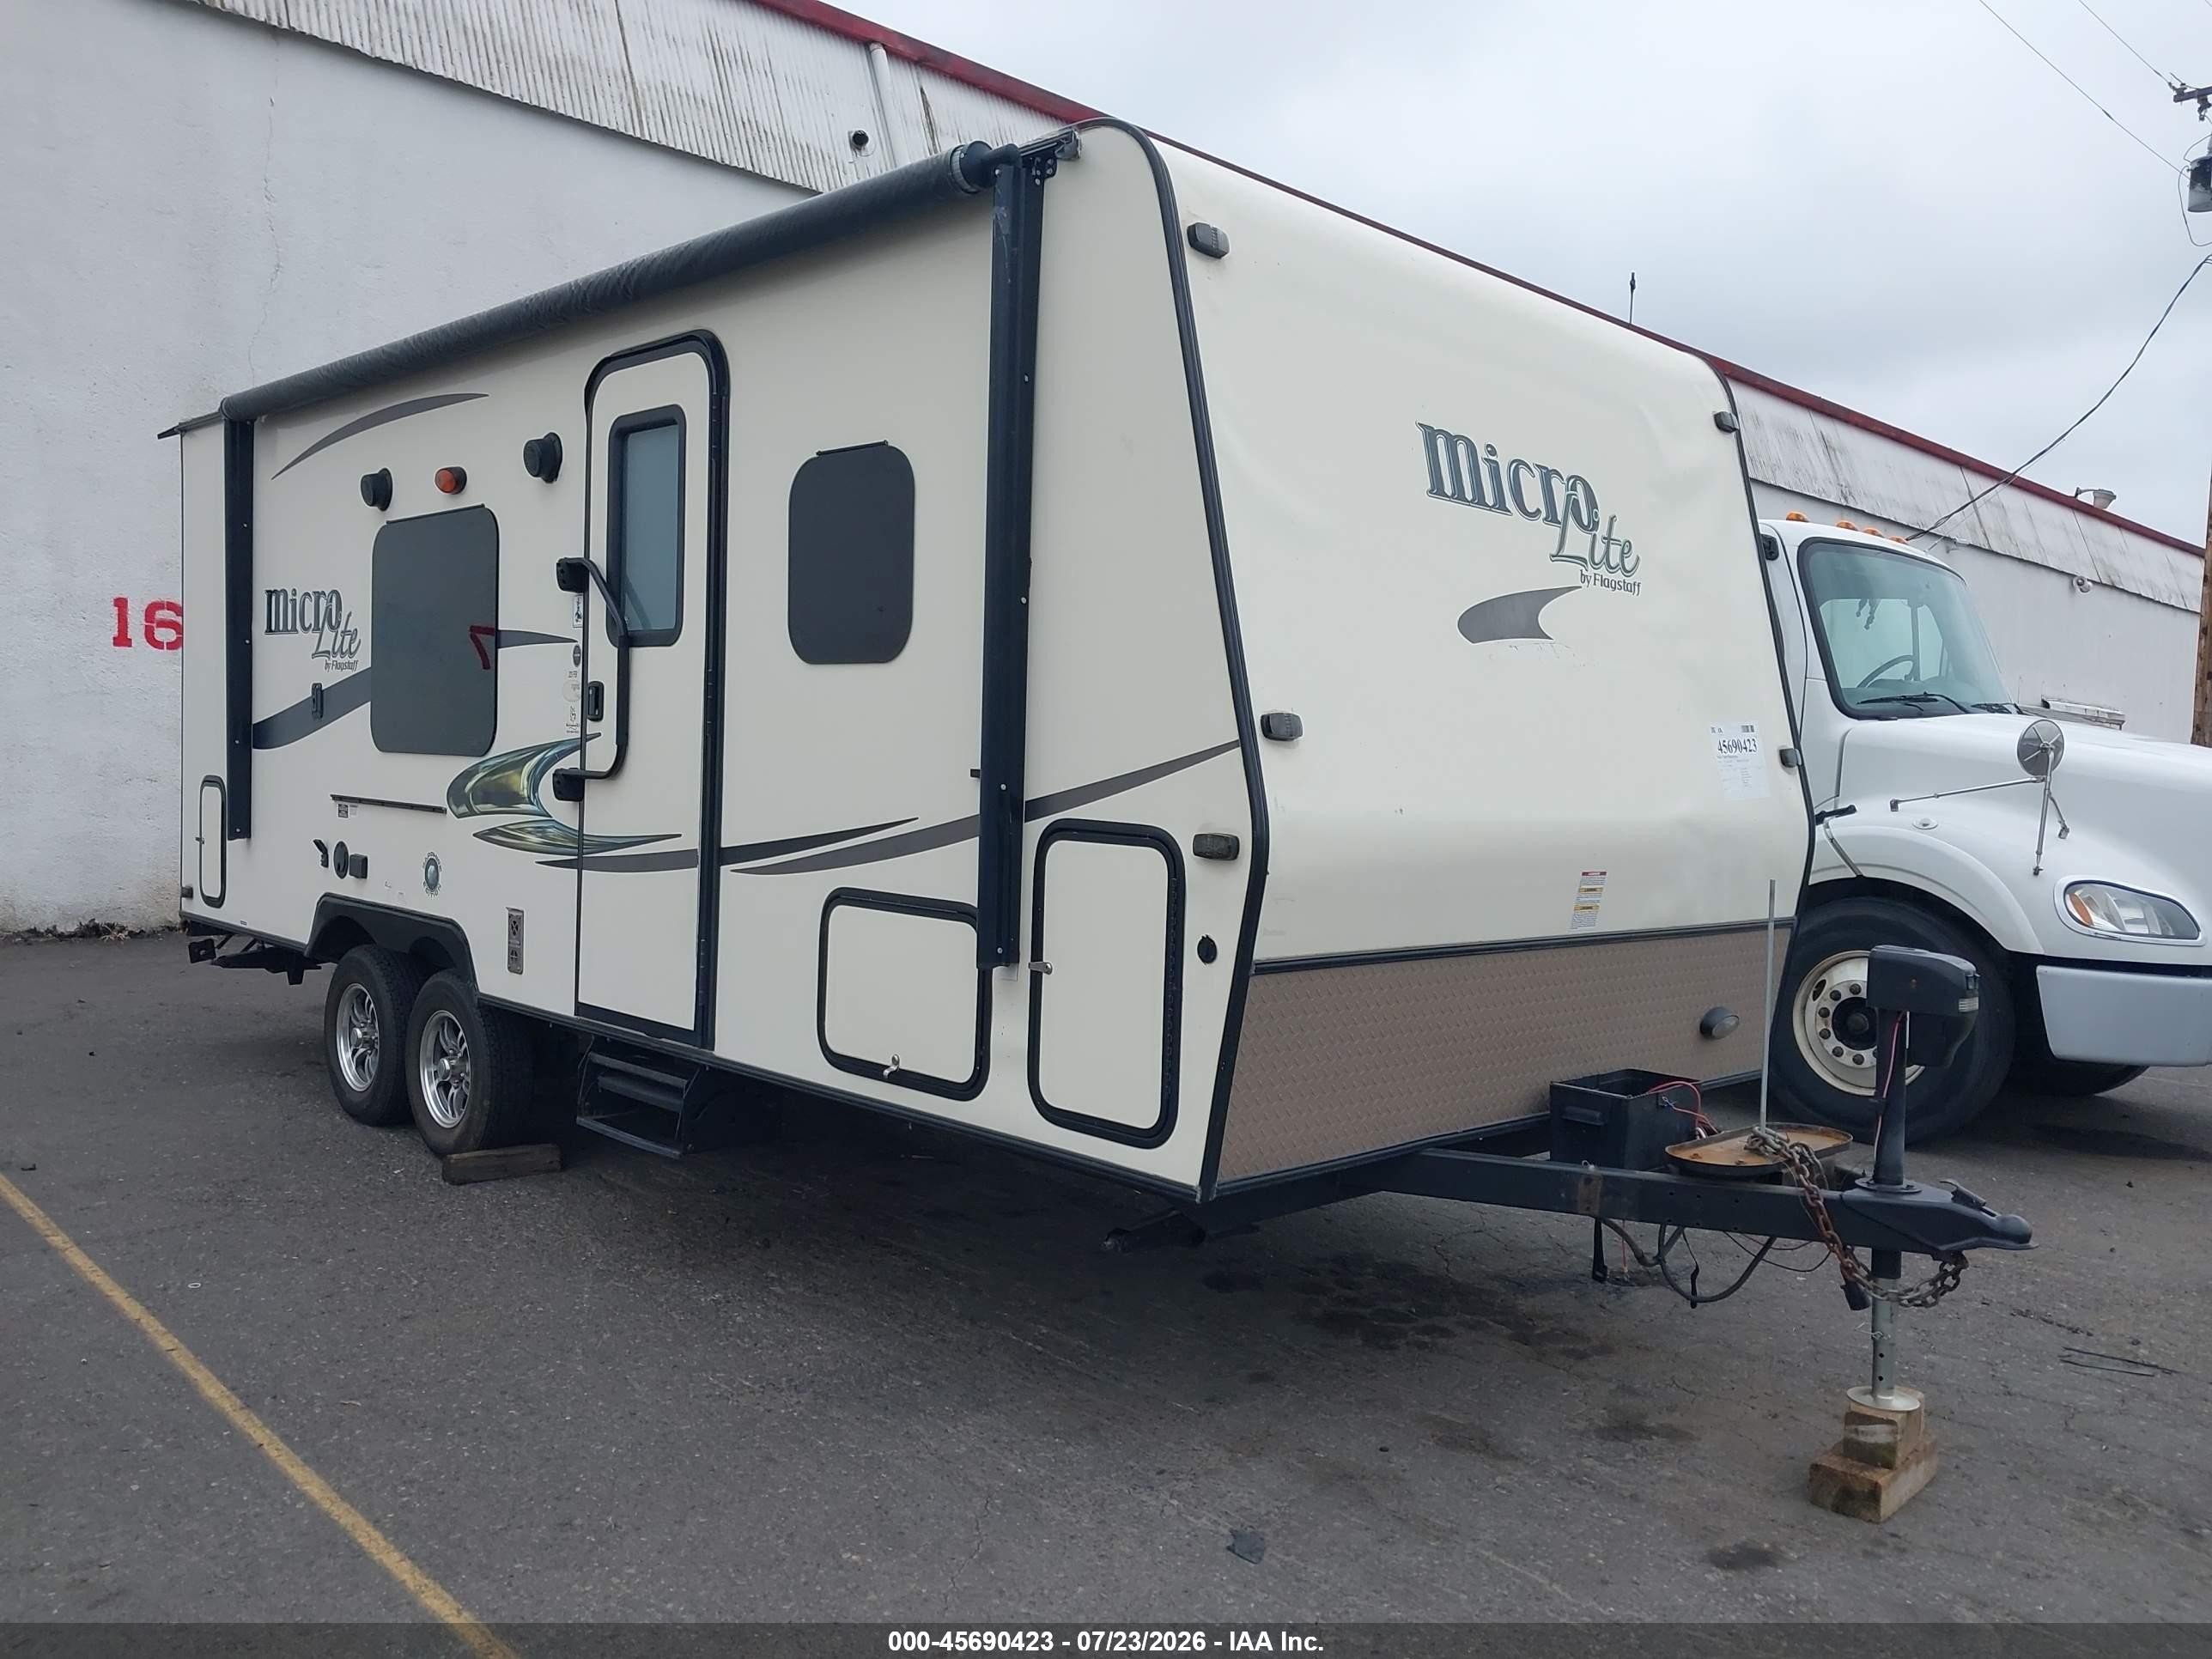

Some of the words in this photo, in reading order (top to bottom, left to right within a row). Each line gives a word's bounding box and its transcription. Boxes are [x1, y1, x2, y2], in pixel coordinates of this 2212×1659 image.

[1415, 421, 1600, 534] micro
[1549, 489, 1641, 578] Lite
[1580, 569, 1592, 587] by
[1593, 573, 1642, 596] Flagstaff
[112, 597, 183, 651] 16
[264, 588, 343, 635] micro
[312, 603, 362, 659] Lite
[325, 659, 332, 673] by
[331, 659, 359, 672] Flagstaff
[1717, 738, 1758, 754] 45690423
